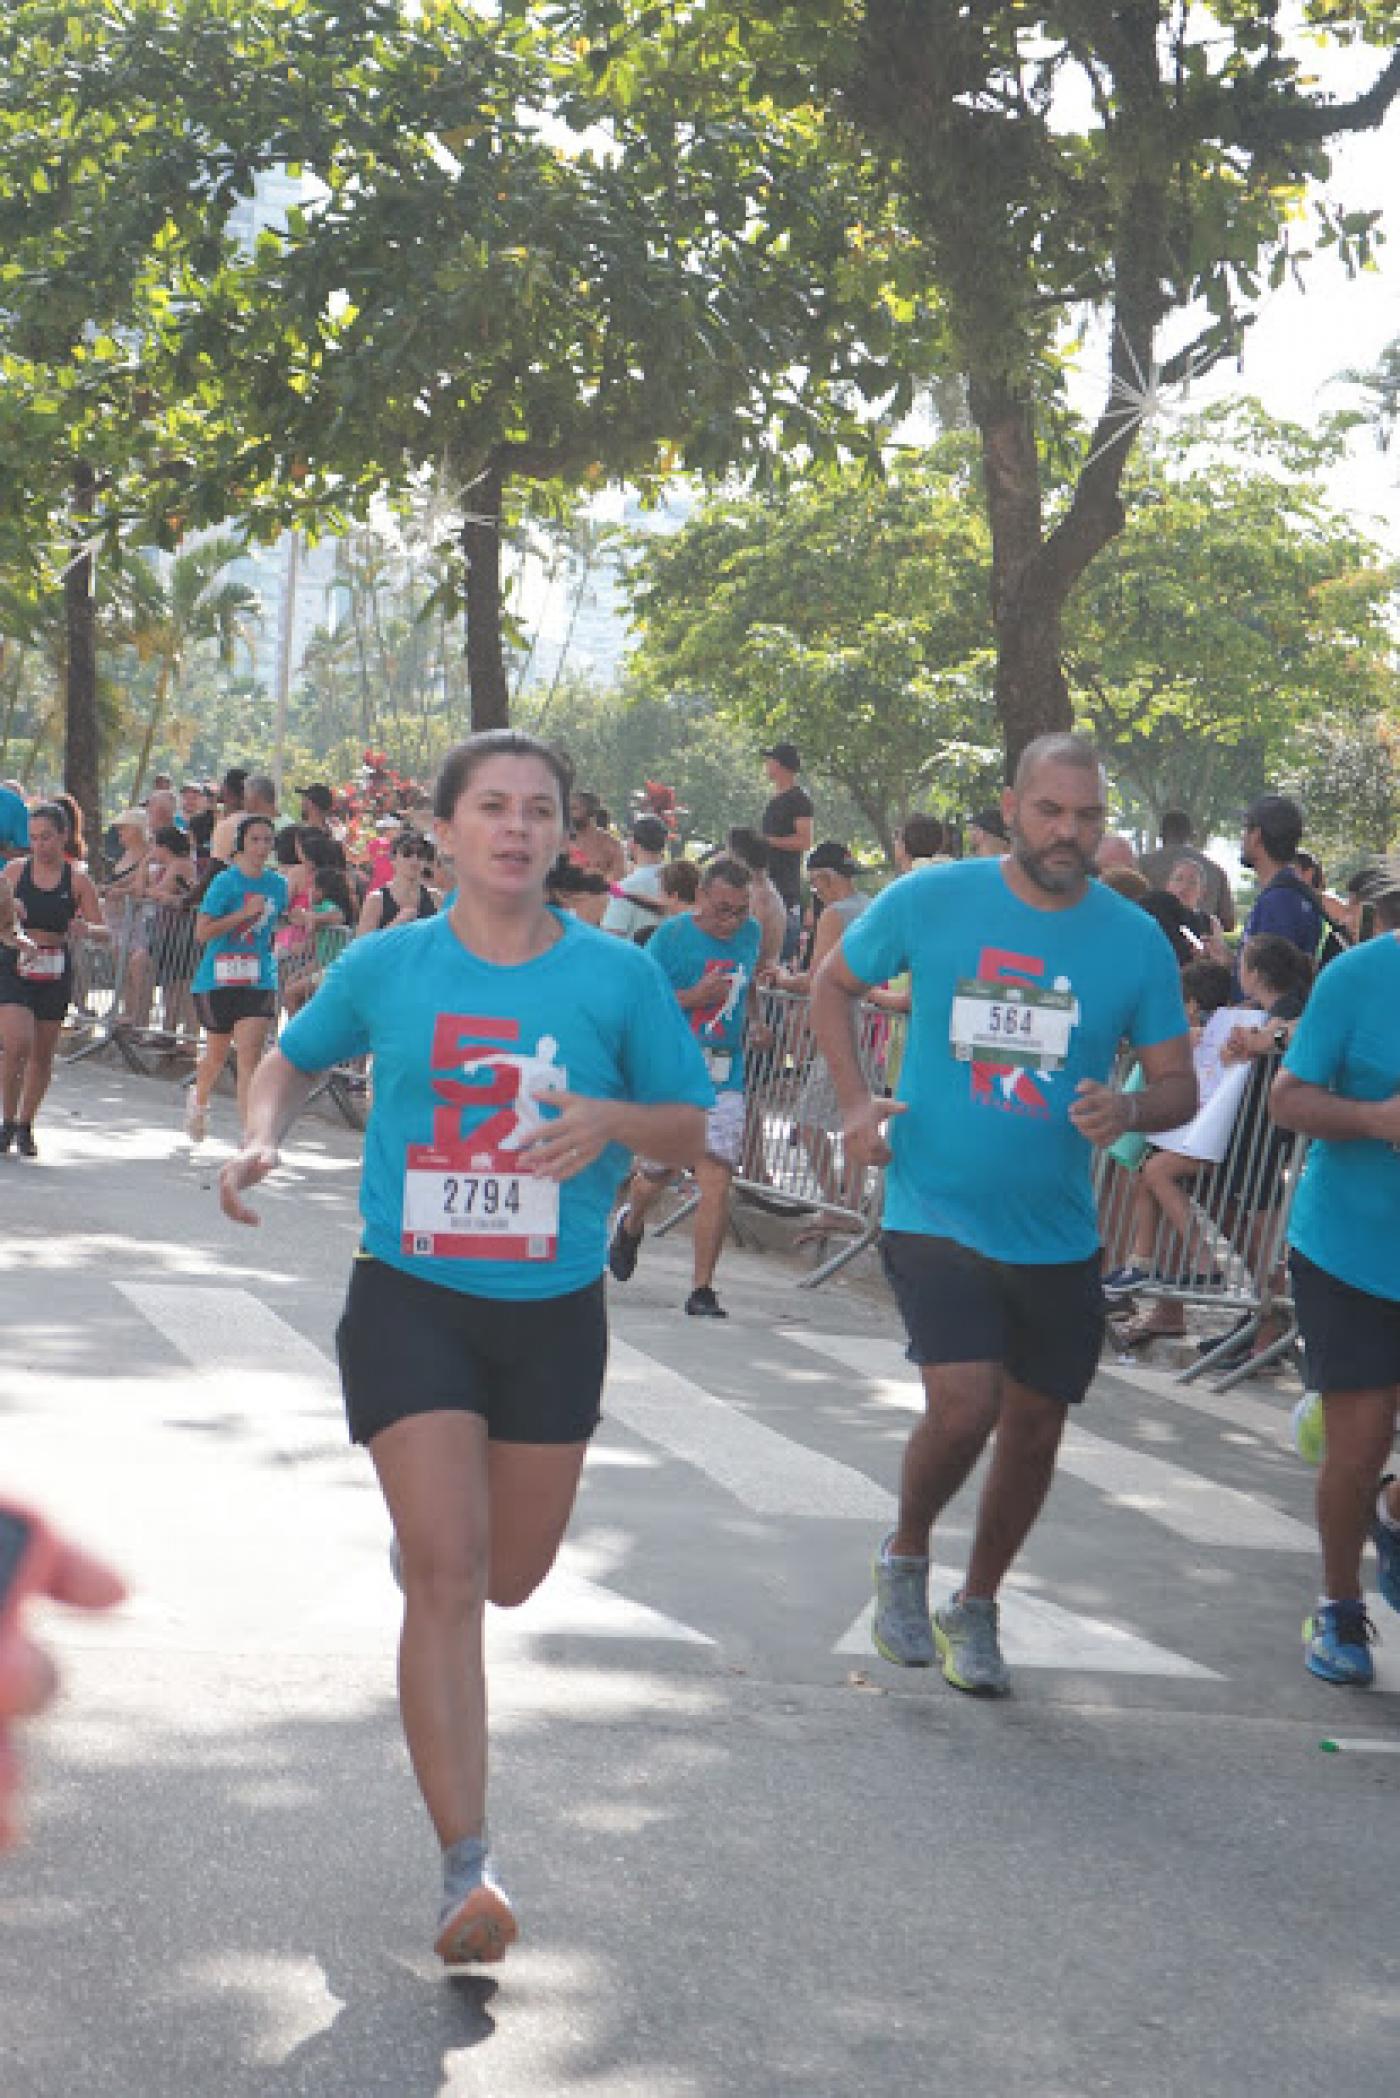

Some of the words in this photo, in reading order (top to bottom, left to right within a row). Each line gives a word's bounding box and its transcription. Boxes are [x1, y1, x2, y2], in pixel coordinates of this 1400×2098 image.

[989, 1006, 1031, 1035] 564
[431, 1013, 520, 1106] 5
[443, 1178, 519, 1214] 2794
